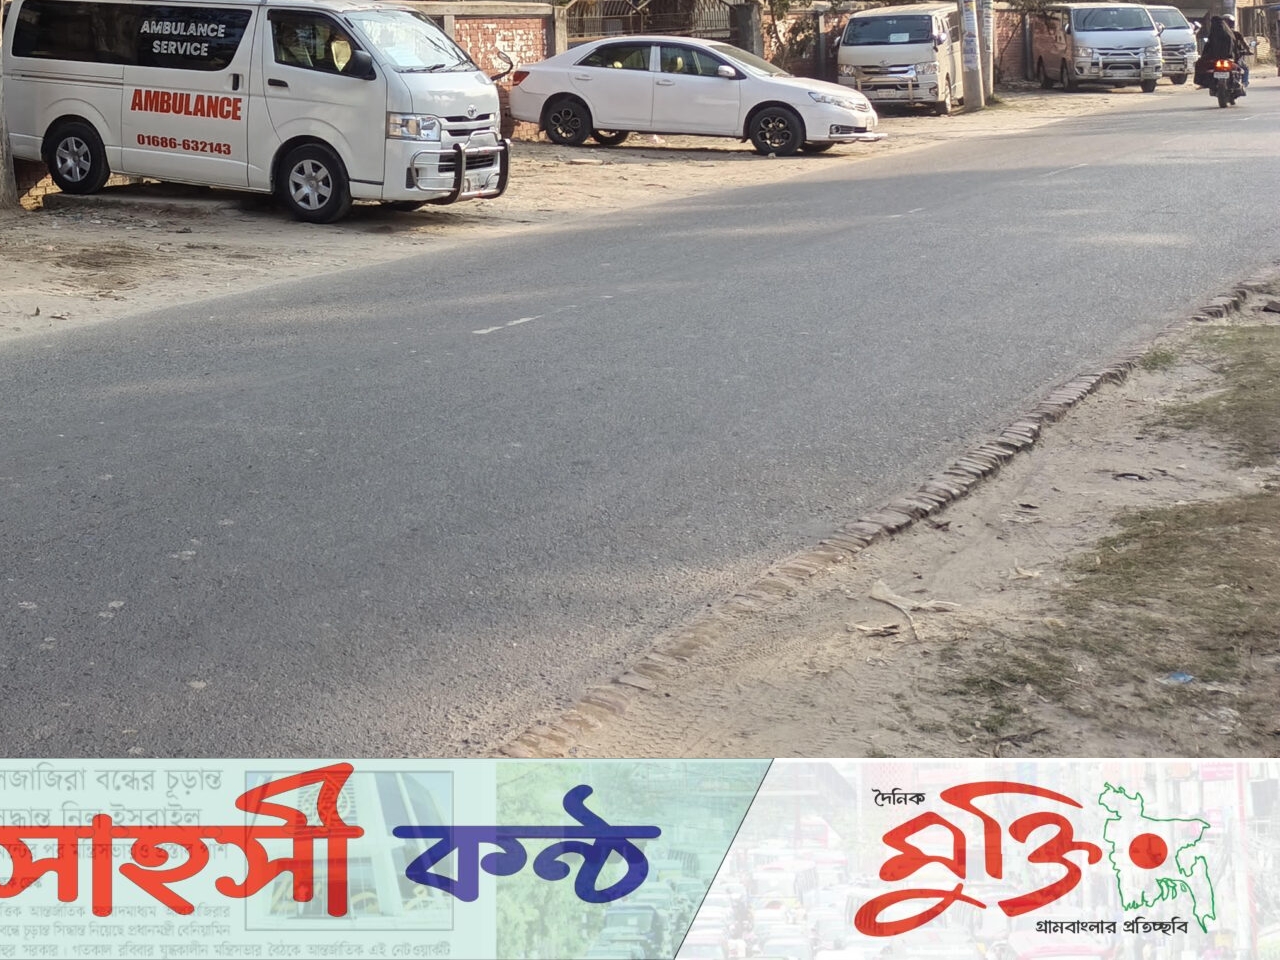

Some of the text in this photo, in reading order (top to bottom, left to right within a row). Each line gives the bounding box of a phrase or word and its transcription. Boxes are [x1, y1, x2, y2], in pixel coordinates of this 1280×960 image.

[140, 20, 226, 38] AMBULANCE
[152, 40, 209, 56] SERVICE
[131, 88, 243, 121] AMBULANCE
[137, 133, 232, 156] 01686-632143
